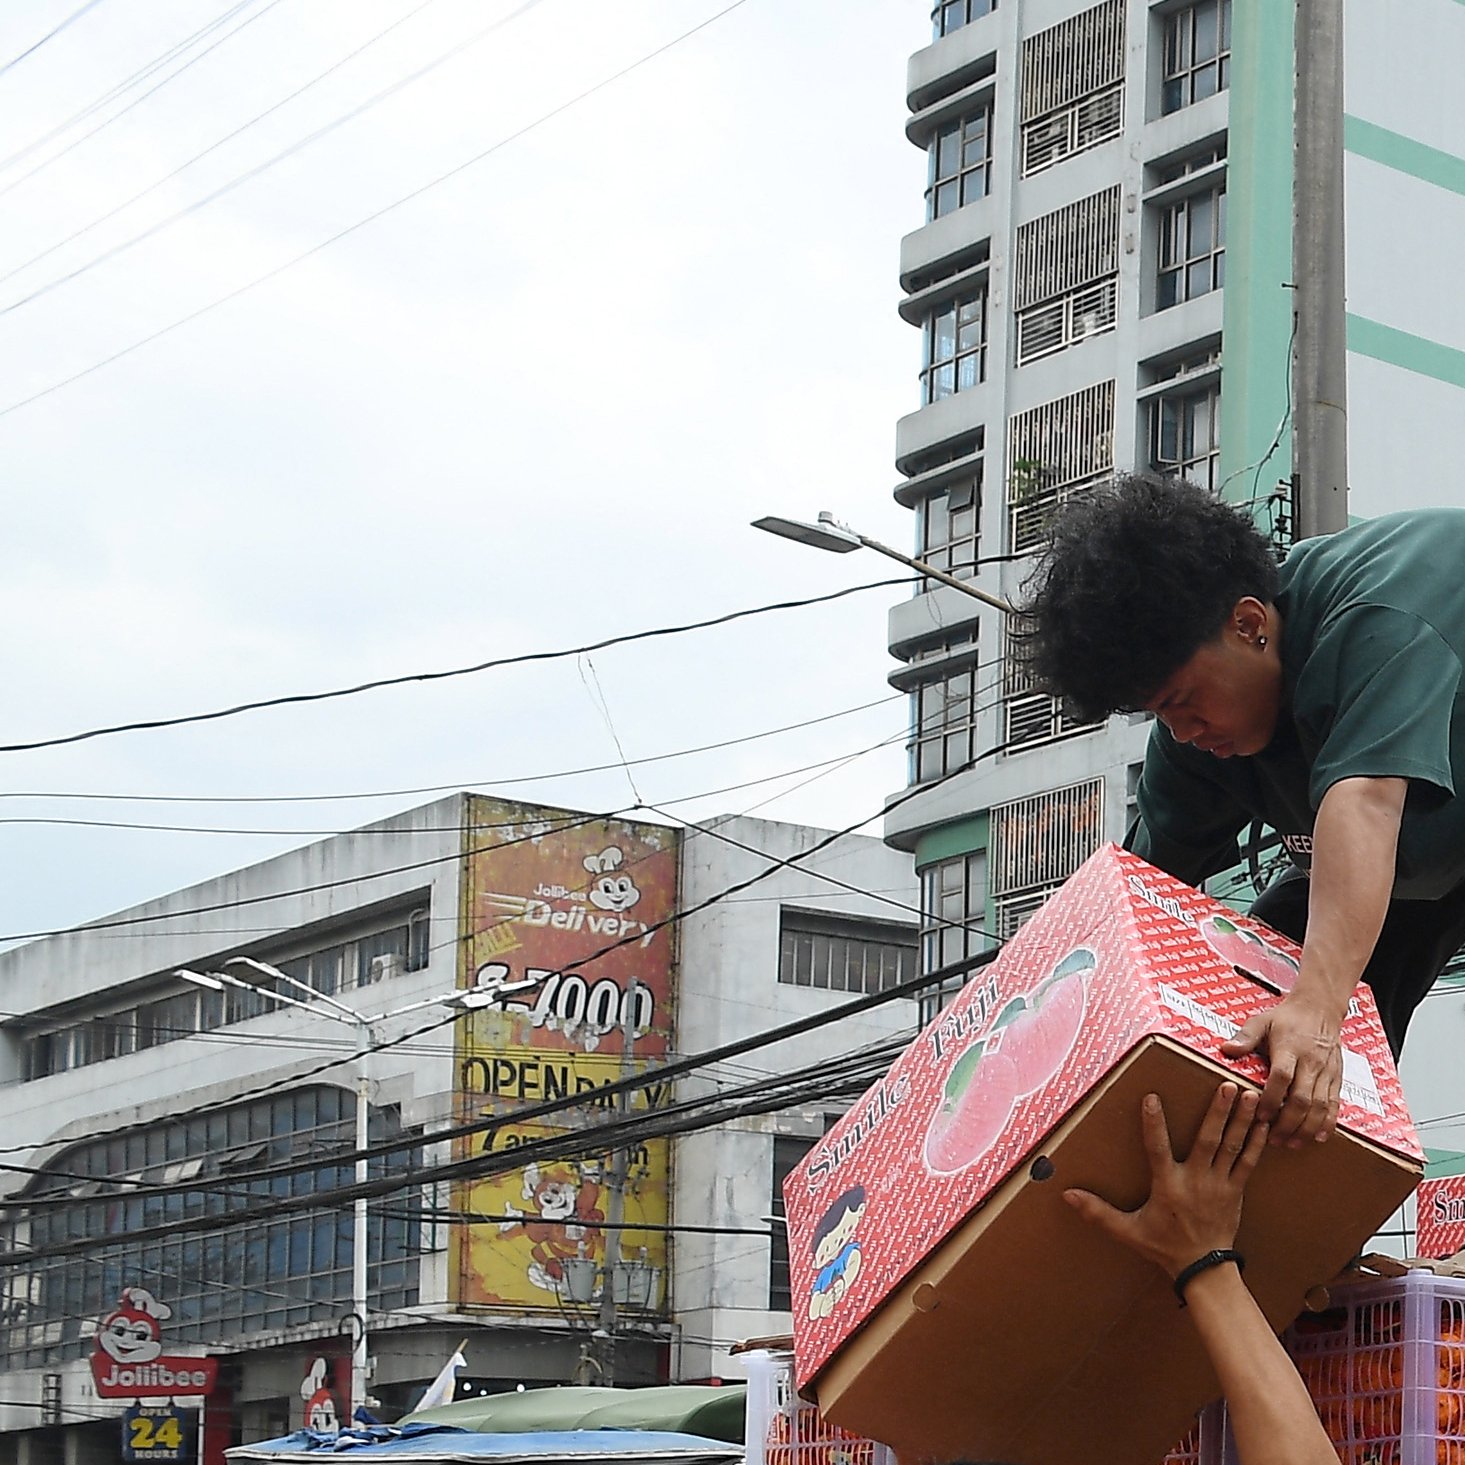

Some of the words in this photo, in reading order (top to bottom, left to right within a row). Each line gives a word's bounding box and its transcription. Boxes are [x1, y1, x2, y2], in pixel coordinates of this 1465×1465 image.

[1128, 875, 1194, 923] Smile
[524, 900, 655, 948] Delivery
[462, 1057, 568, 1100] OPEN
[806, 1074, 911, 1197] Smile
[929, 973, 1001, 1063] Fuji
[101, 1365, 207, 1387] Jollibee
[139, 1408, 171, 1416] OPEN
[130, 1418, 183, 1448] 24
[135, 1450, 178, 1458] HOURS
